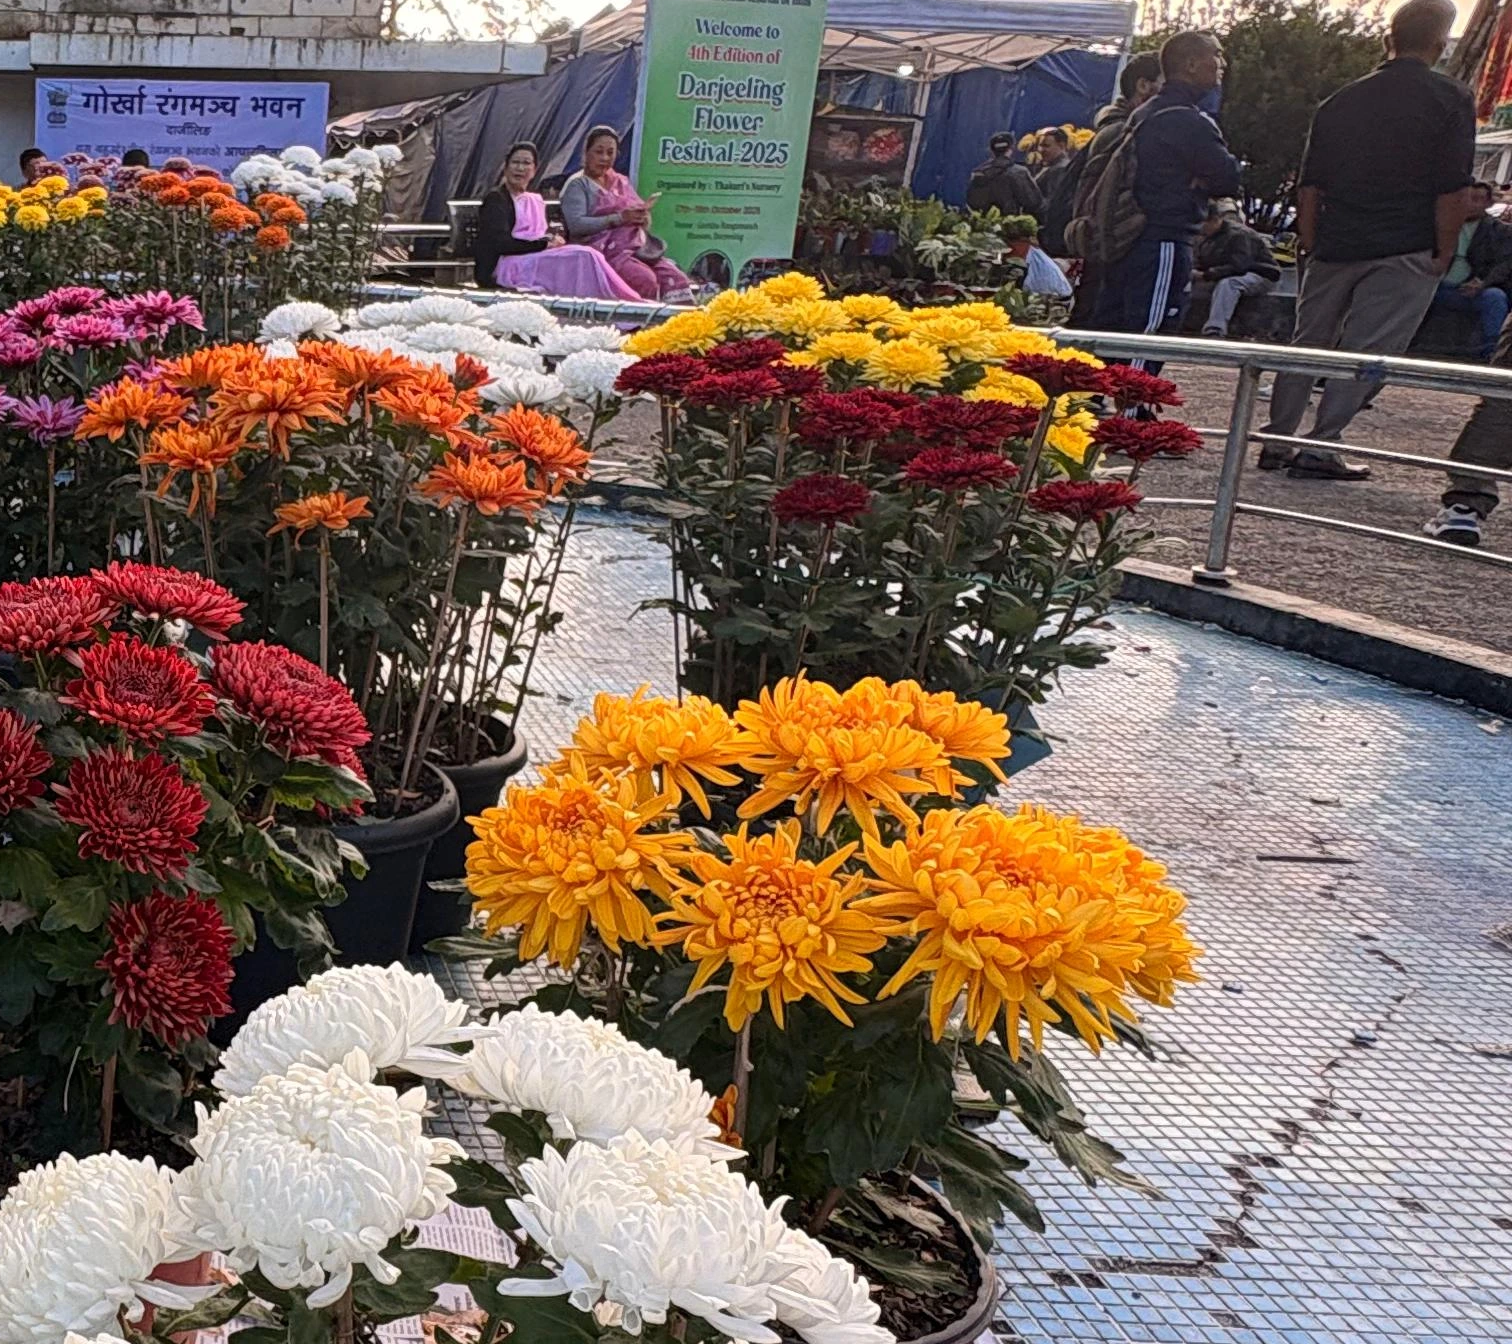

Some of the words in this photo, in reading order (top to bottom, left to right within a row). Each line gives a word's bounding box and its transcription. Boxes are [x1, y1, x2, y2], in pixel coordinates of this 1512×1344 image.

[696, 18, 762, 39] Welcome
[766, 25, 780, 40] to
[713, 45, 764, 64] Edition
[766, 50, 782, 66] of
[82, 85, 146, 115] गोर्खा
[251, 95, 306, 118] भवन
[678, 71, 786, 107] Darjeeling
[693, 108, 764, 133] Flower
